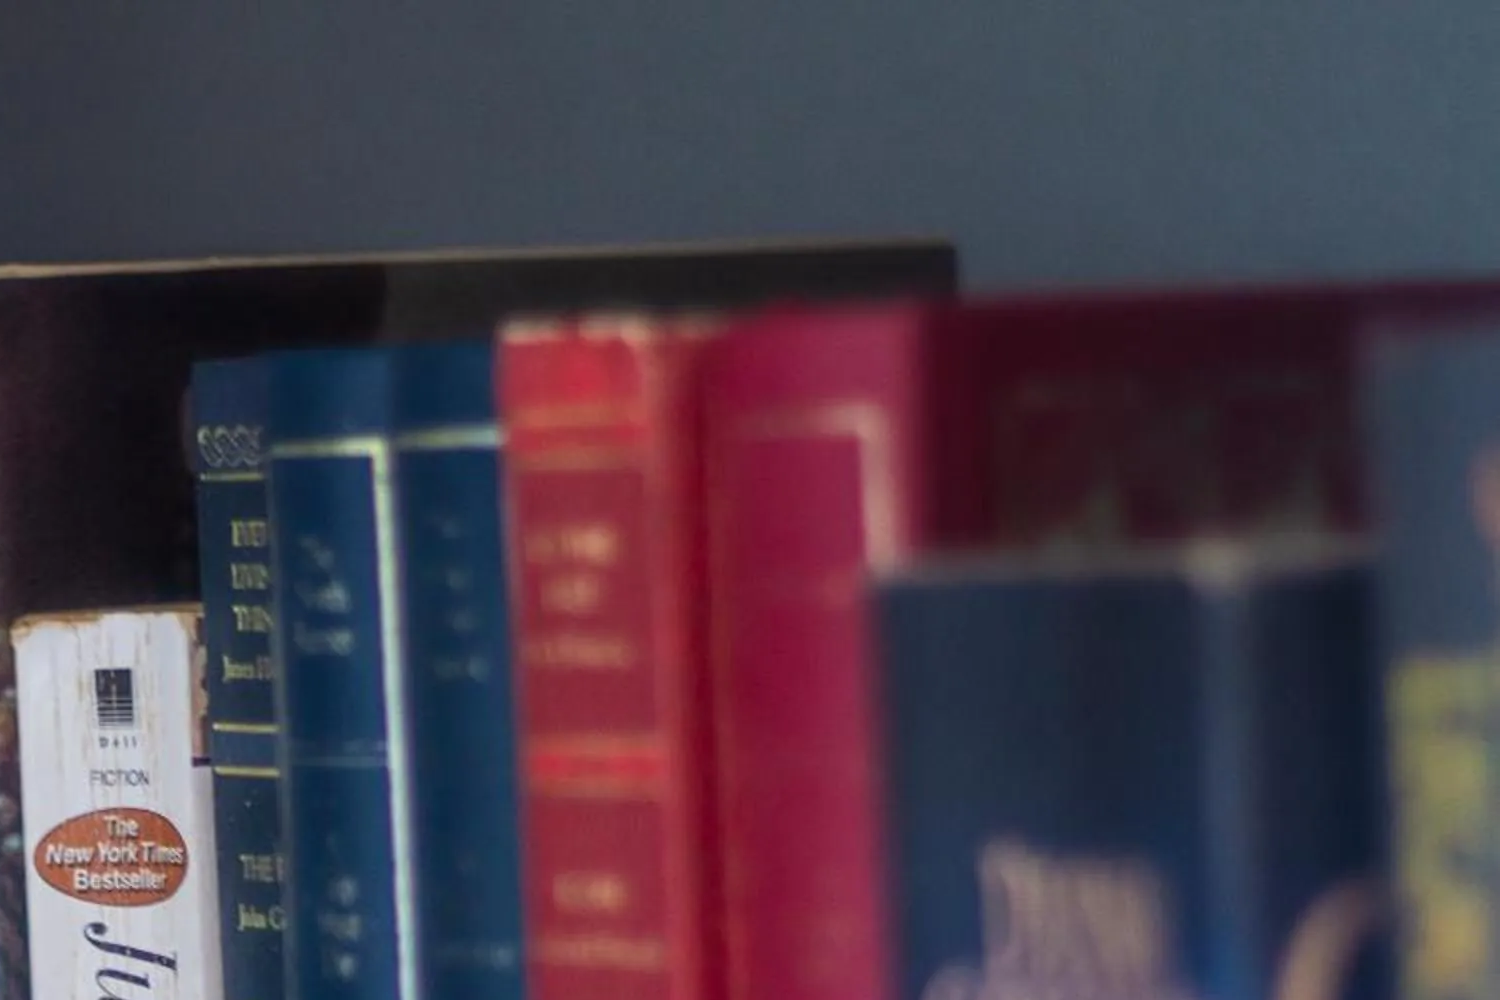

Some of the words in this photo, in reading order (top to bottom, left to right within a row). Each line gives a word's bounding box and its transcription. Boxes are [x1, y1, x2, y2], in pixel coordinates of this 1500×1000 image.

[89, 769, 150, 788] FICTION
[102, 814, 140, 839] The
[45, 842, 93, 866] New
[96, 842, 140, 865] York
[141, 841, 184, 866] Times
[73, 867, 168, 893] Bestseller
